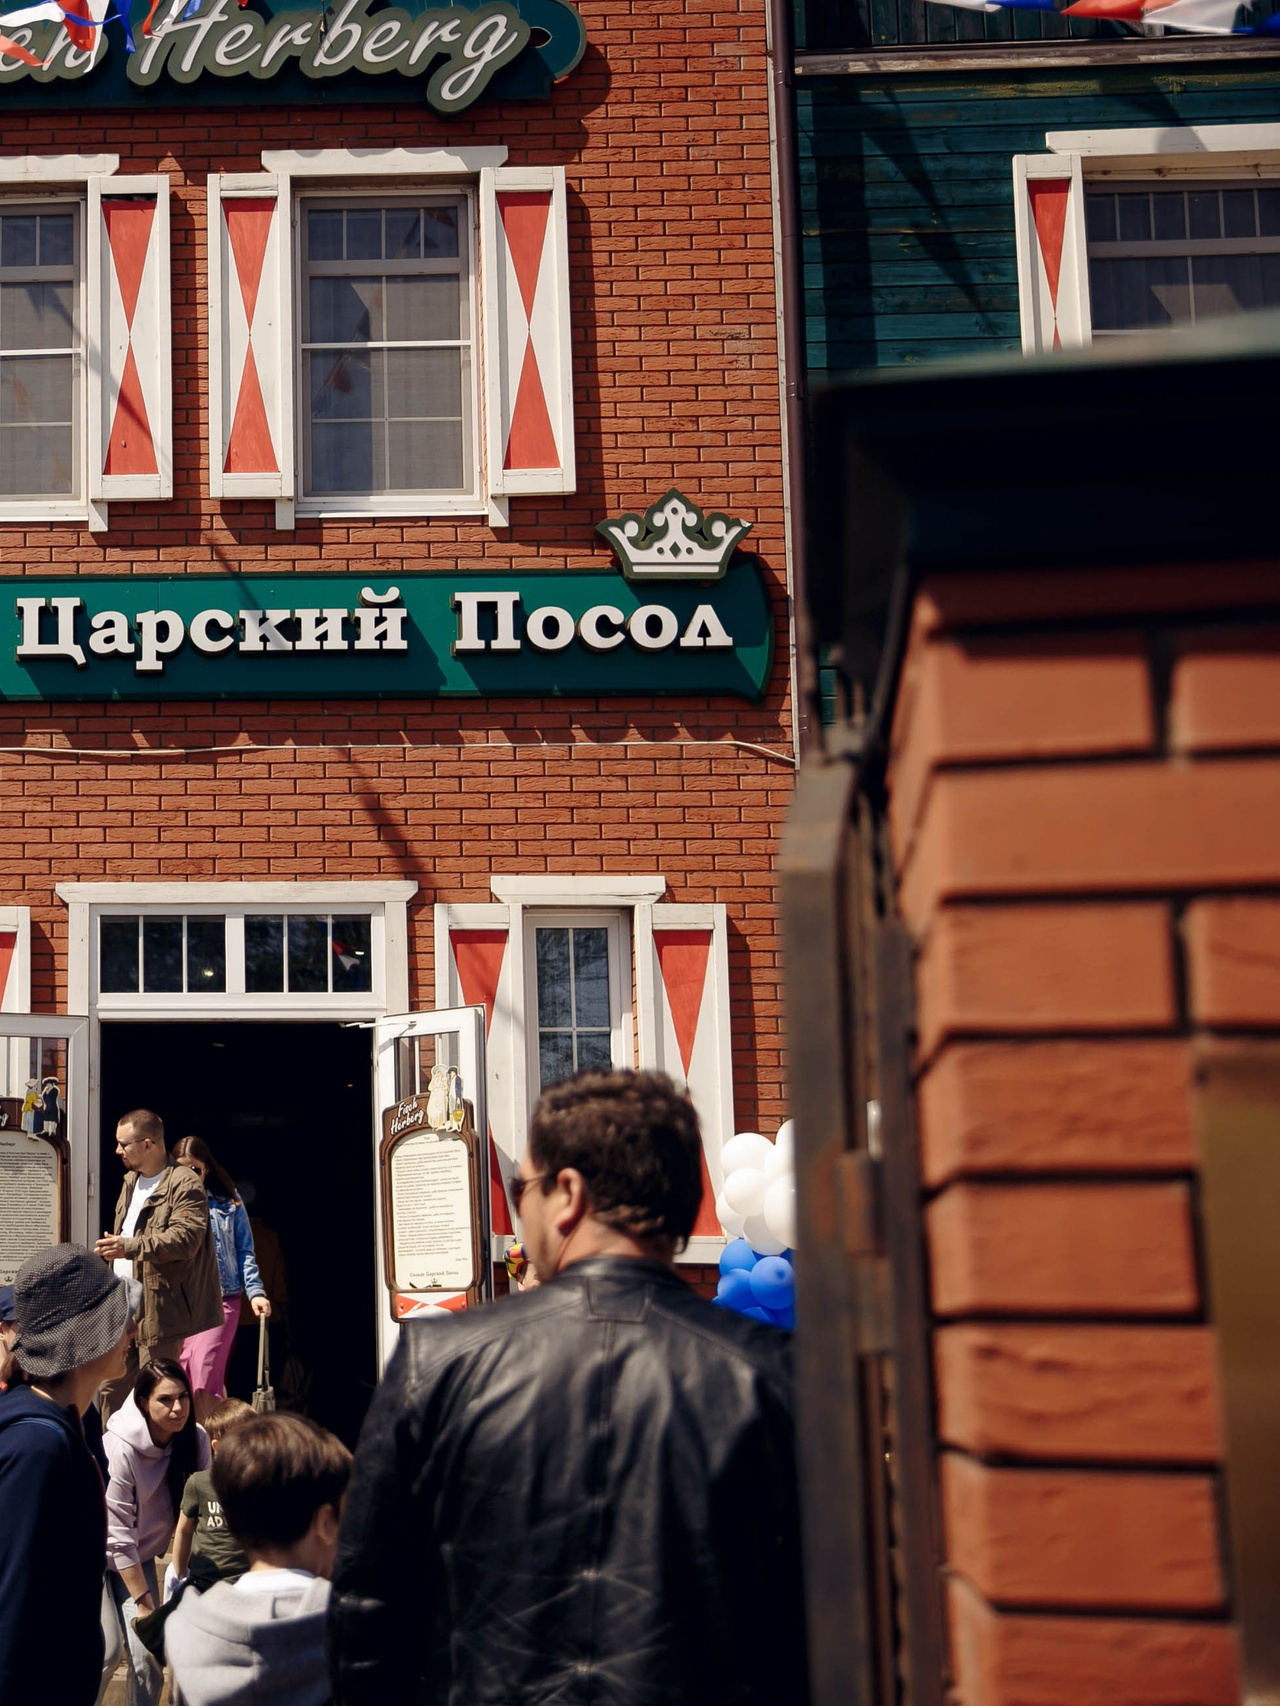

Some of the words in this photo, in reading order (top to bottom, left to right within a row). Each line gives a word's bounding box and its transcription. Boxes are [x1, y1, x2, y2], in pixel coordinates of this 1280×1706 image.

[138, 0, 518, 101] Herberg
[16, 586, 408, 671] Царский
[453, 591, 734, 653] Посол
